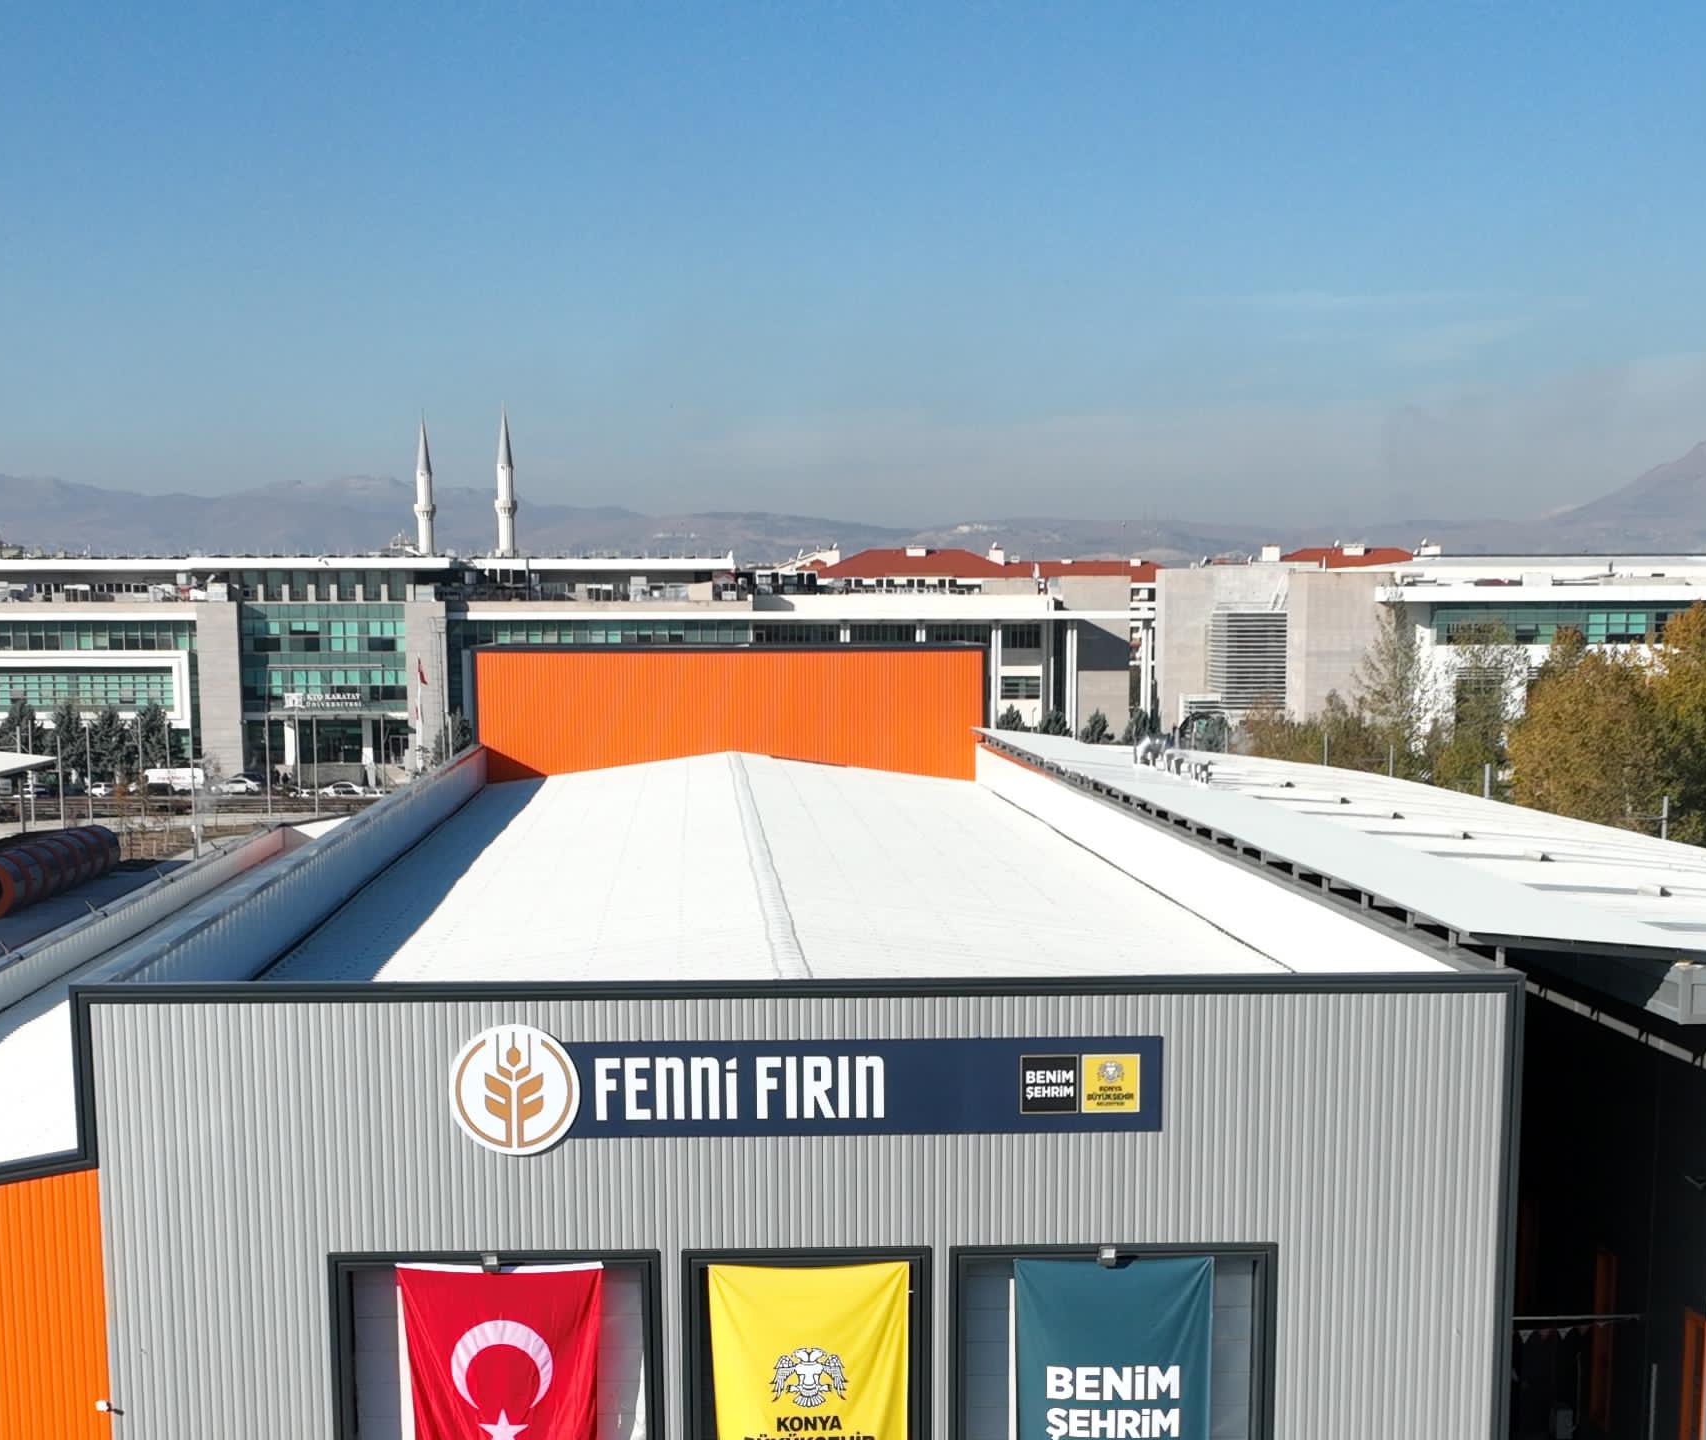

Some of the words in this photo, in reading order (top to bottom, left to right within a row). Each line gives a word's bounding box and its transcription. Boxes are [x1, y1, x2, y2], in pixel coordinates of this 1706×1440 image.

[325, 692, 360, 700] KARATAY
[756, 1055, 885, 1120] FIRIN
[1046, 1365, 1180, 1401] BENİM
[776, 1415, 842, 1432] KONYA
